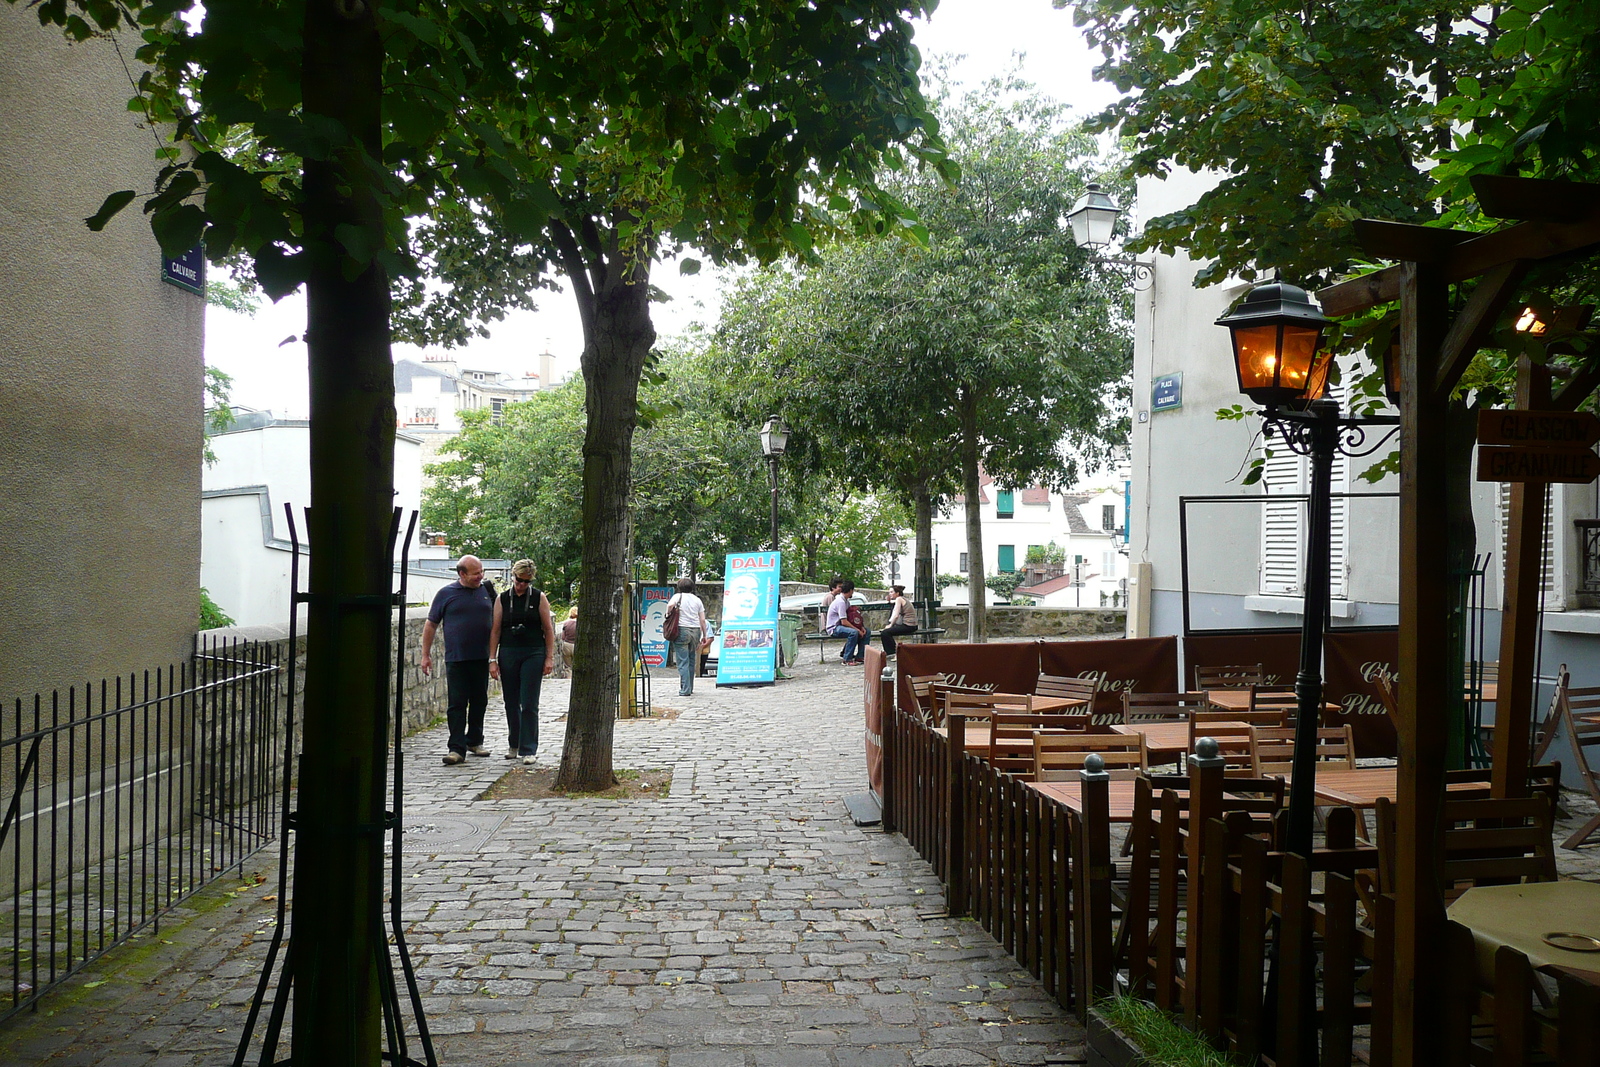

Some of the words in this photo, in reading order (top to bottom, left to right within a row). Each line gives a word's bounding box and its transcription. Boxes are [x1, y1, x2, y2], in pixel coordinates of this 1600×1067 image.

[172, 262, 196, 281] CALVAIRE
[1500, 415, 1591, 442] GLASGOW
[1490, 451, 1592, 479] GRANVILLE
[1360, 661, 1399, 684] Che
[1338, 693, 1388, 715] Plu
